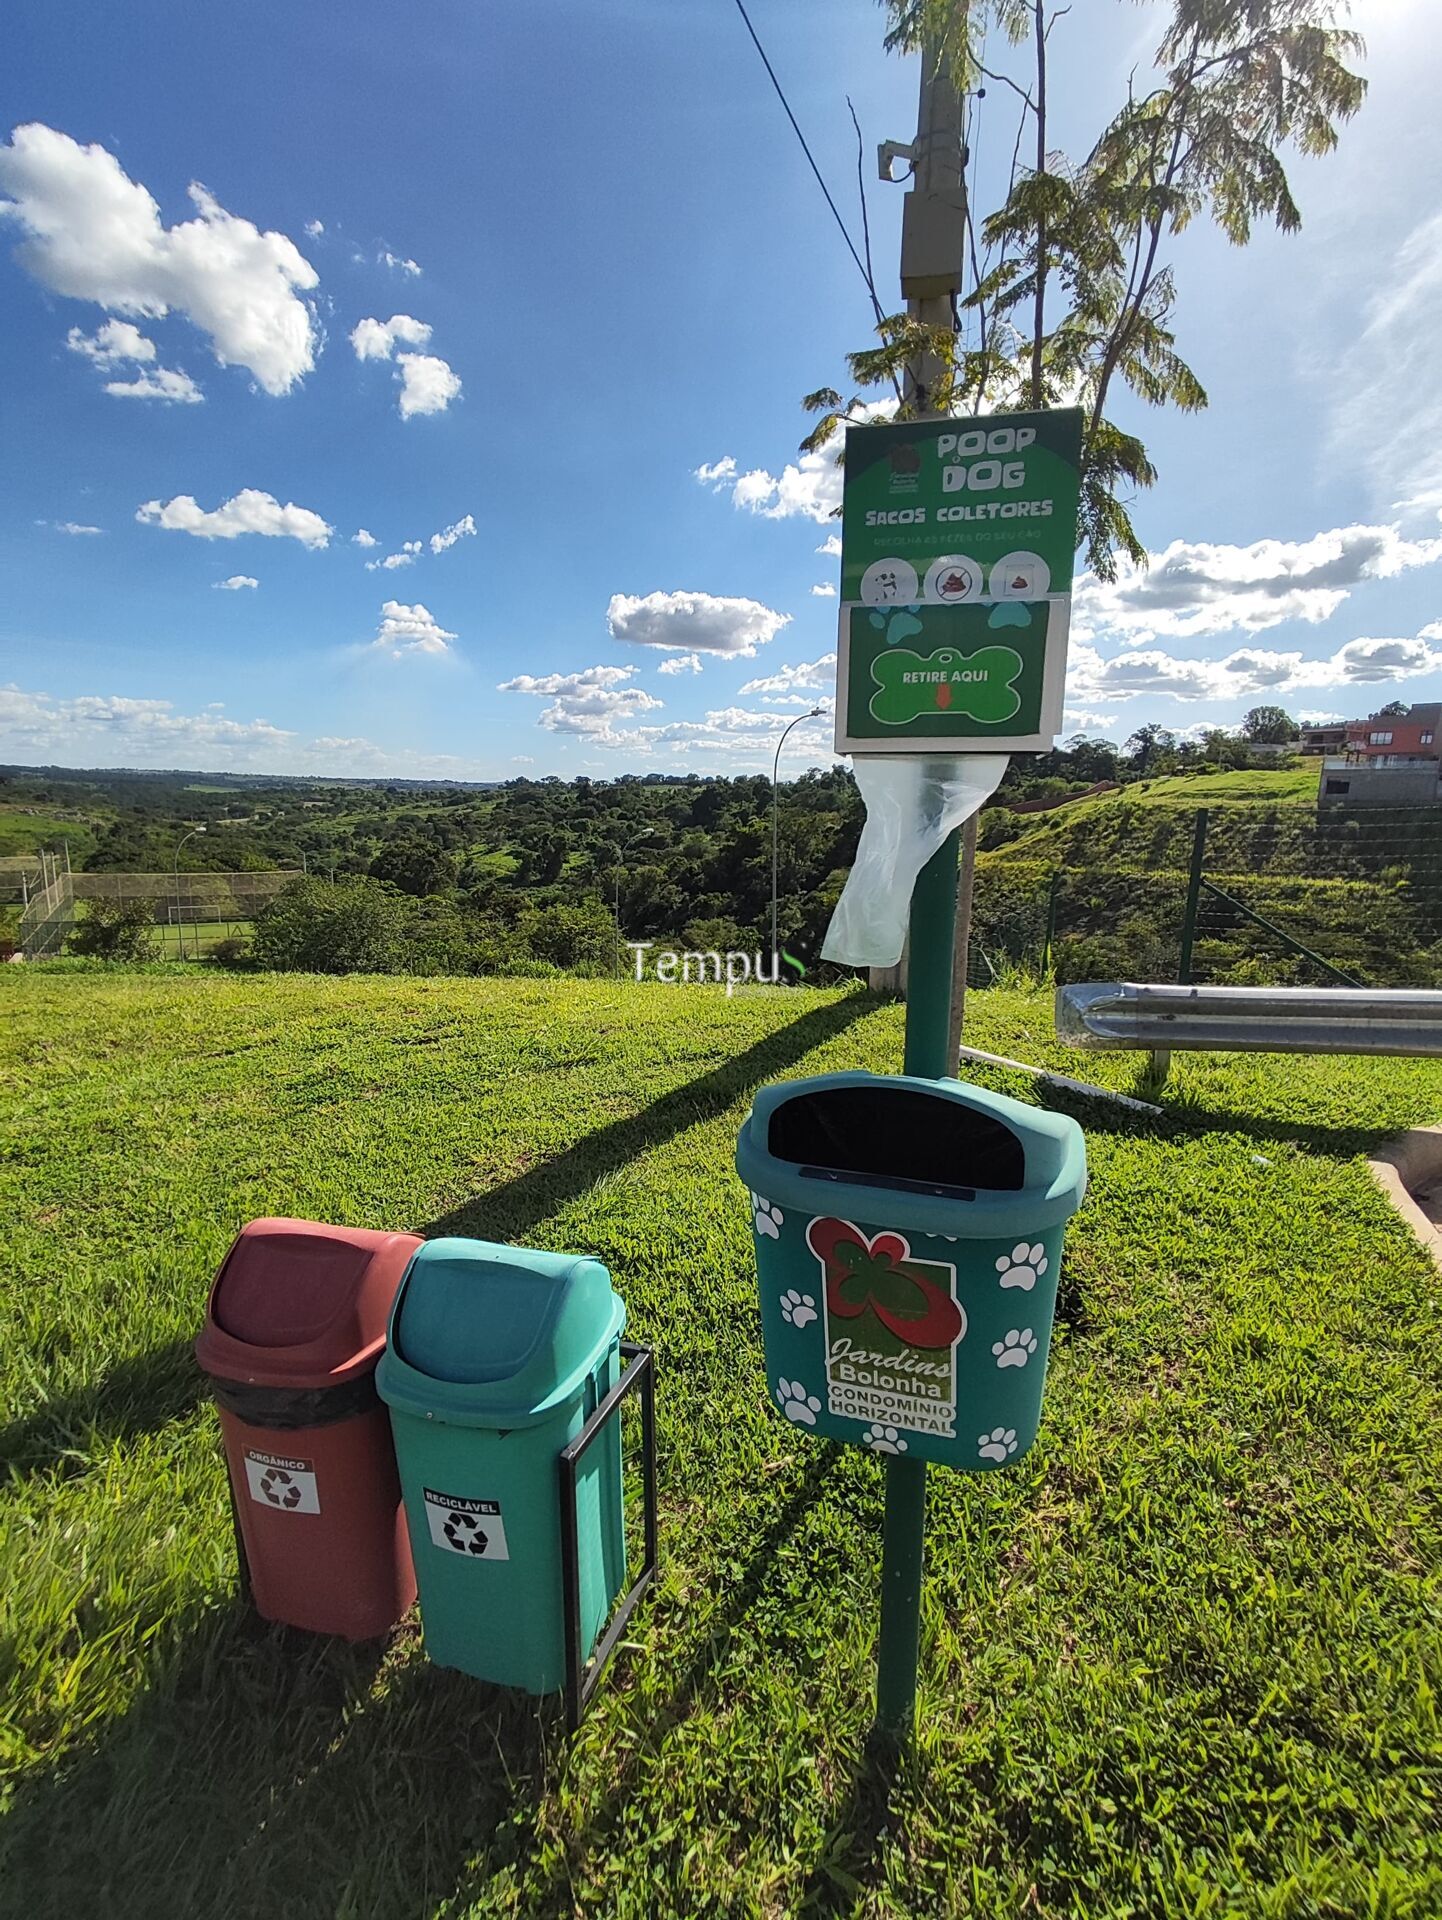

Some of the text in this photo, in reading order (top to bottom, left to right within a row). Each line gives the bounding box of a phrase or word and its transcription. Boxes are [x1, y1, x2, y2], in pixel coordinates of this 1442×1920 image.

[938, 428, 1037, 458] POOP
[942, 460, 1026, 493] DOG
[865, 500, 1053, 526] SACOS COLETORES
[902, 669, 989, 684] RETIRE AQUI
[829, 1337, 952, 1377] Jardins
[840, 1363, 941, 1398] Bolonha
[831, 1386, 952, 1418] CONDOMÍNIO
[831, 1400, 952, 1434] HORIZONTAL
[426, 1491, 497, 1513] RECICLÁVEL
